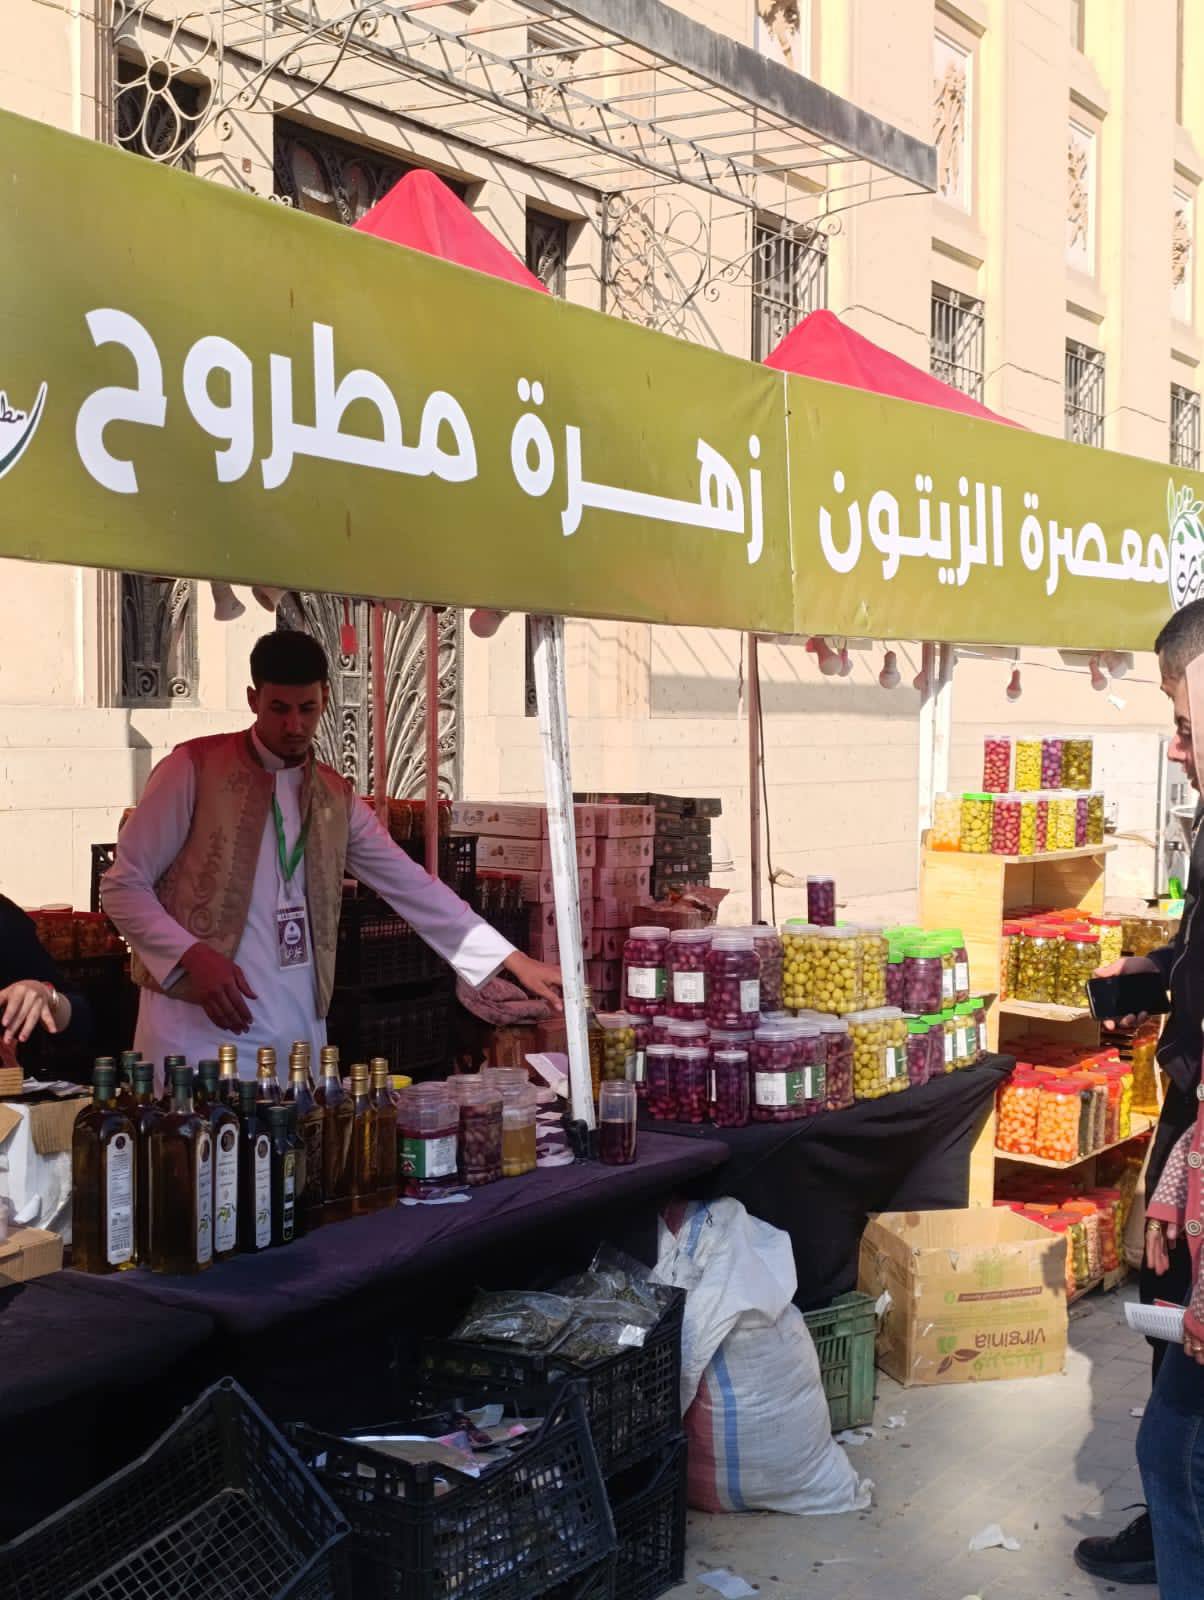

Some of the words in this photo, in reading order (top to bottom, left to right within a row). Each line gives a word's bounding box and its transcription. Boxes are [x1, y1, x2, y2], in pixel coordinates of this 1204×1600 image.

[76, 309, 478, 493] مطروح
[511, 378, 763, 564] زهرة
[819, 471, 1003, 586] الزيتون
[1020, 493, 1168, 596] معصرة
